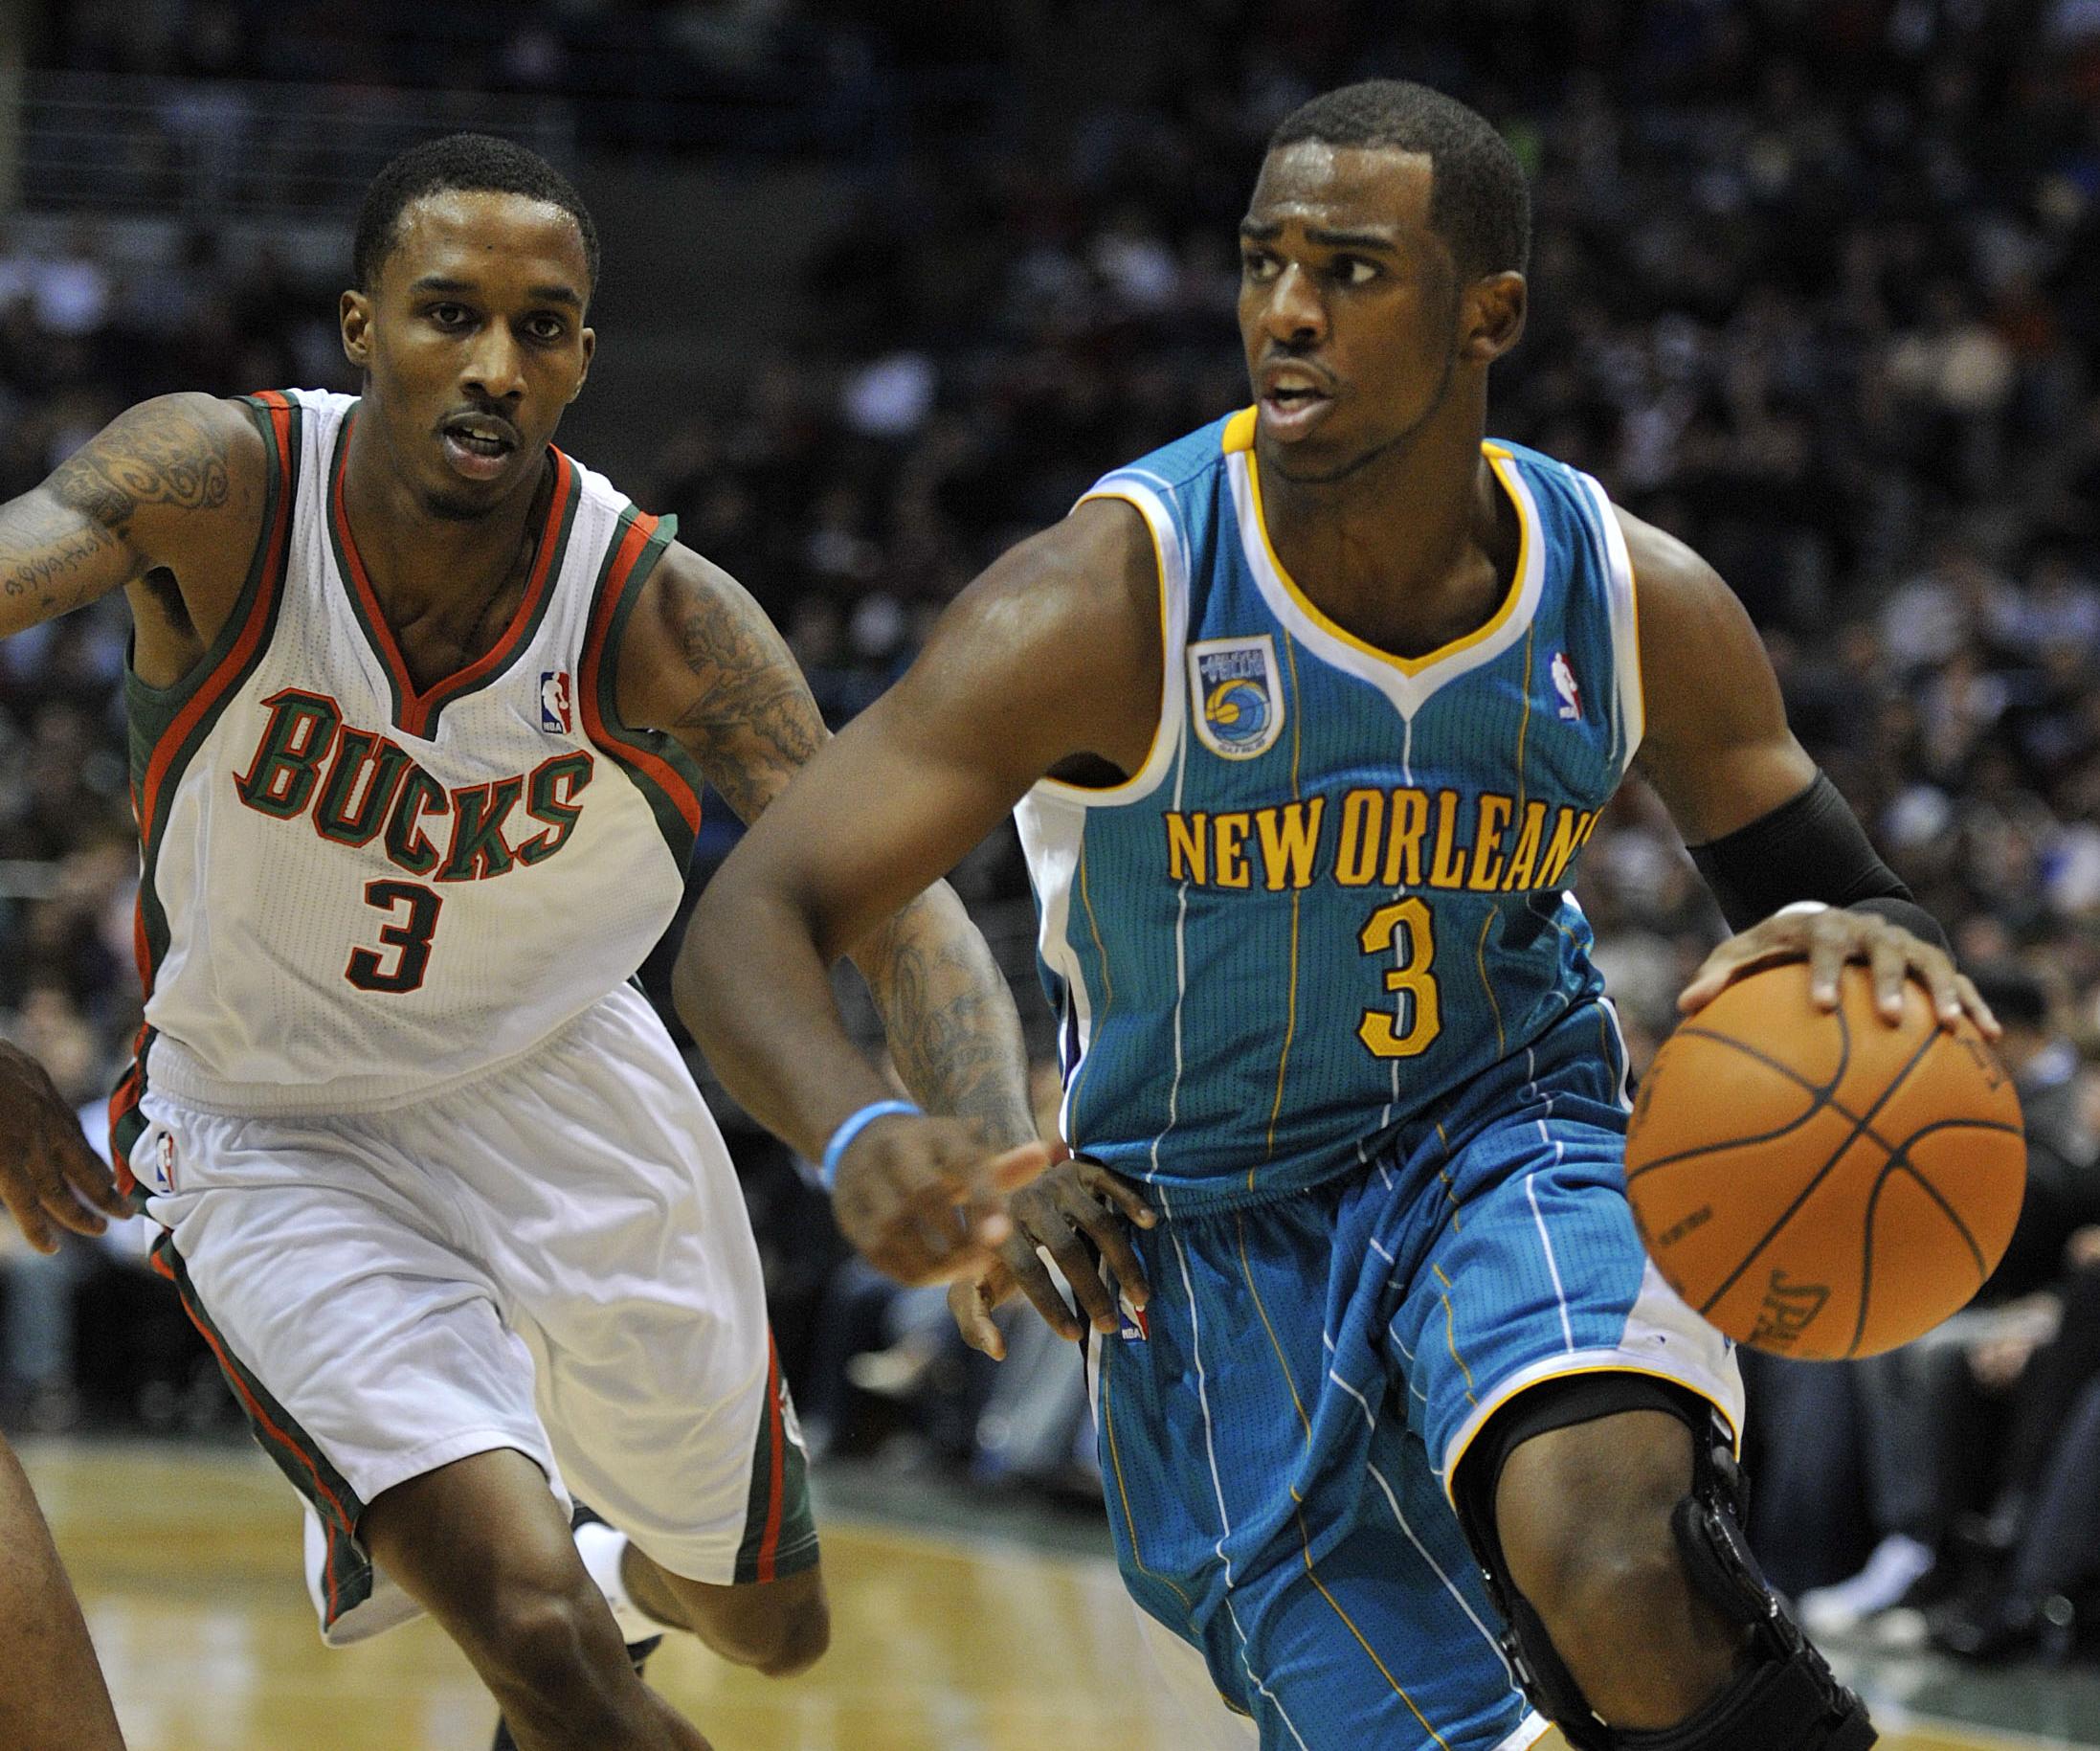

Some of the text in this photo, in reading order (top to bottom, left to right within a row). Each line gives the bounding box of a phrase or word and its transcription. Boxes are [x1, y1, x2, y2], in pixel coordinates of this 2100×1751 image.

[543, 721, 562, 732] NBA
[233, 687, 595, 883] BUCKS
[1163, 787, 1606, 893] NEW ORLEAN
[345, 879, 443, 994] 3
[1355, 894, 1444, 1059] 3
